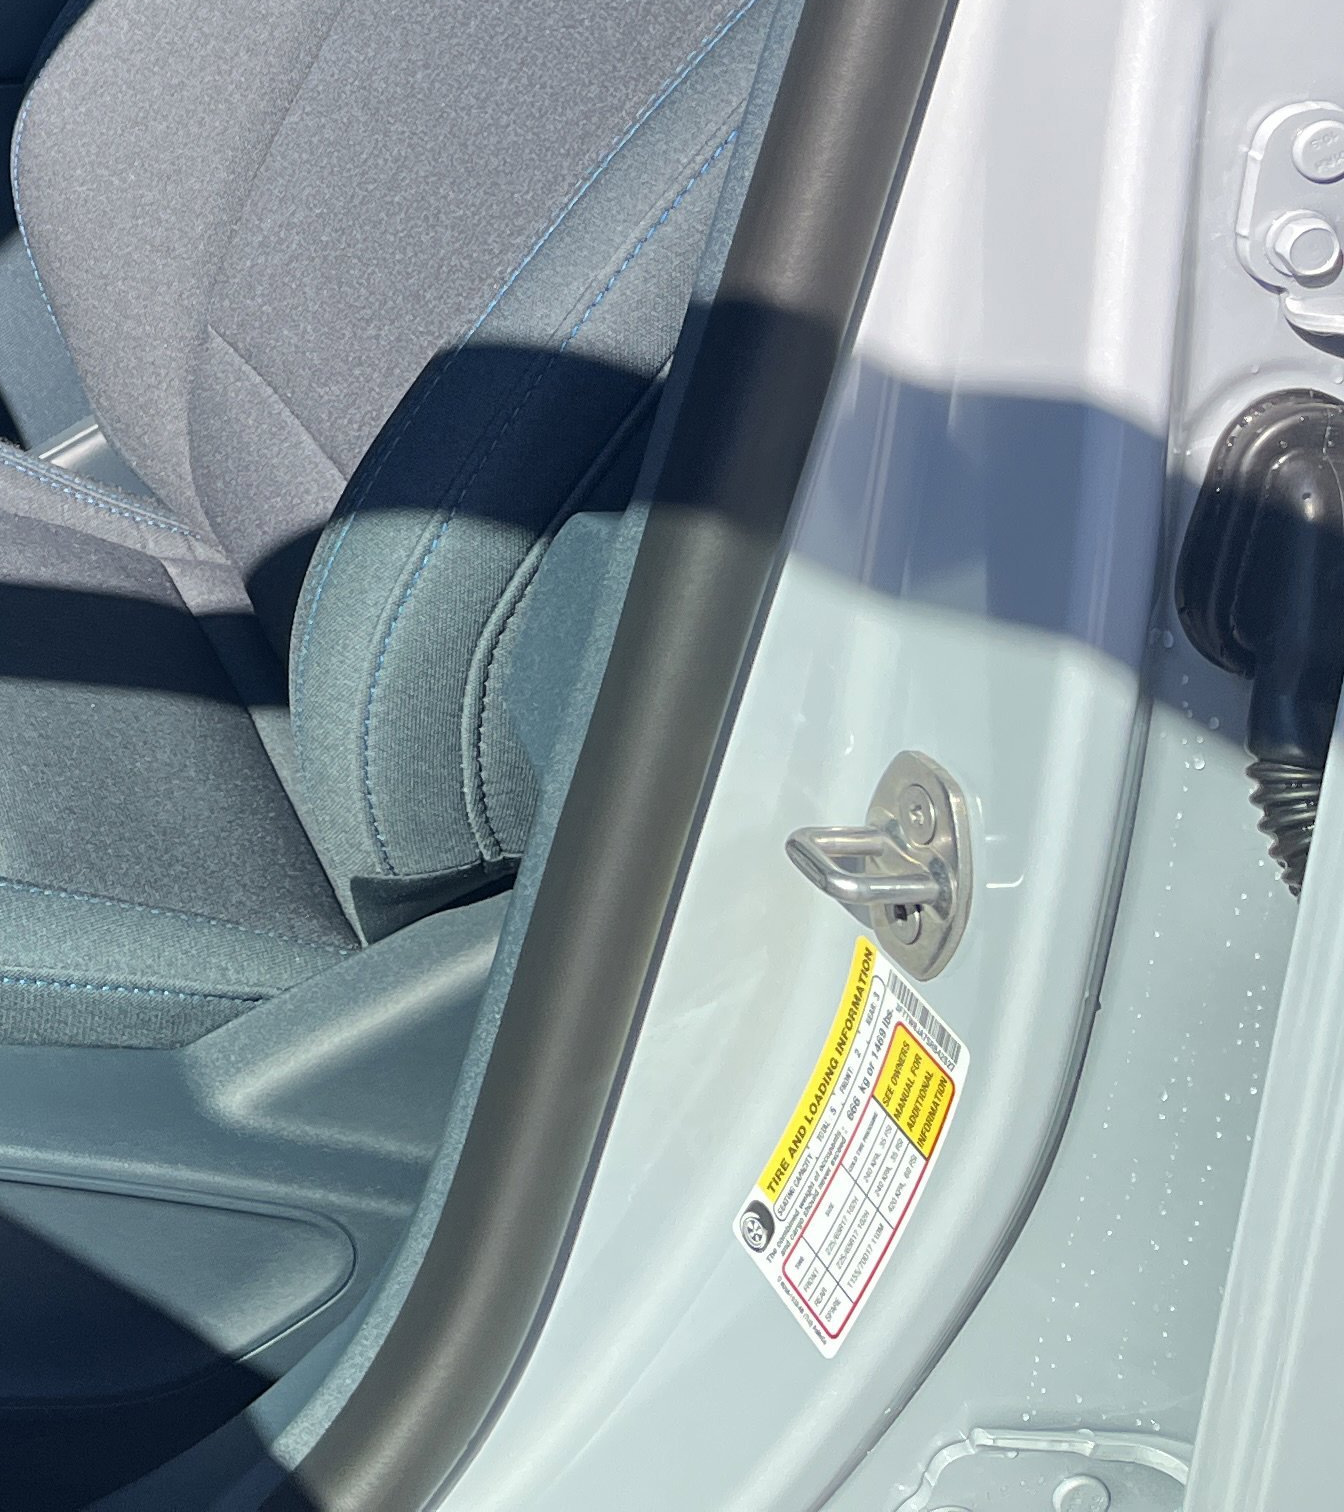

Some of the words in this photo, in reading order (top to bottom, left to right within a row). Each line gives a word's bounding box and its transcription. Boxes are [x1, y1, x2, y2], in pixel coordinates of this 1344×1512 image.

[766, 1156, 791, 1194] TIRE
[787, 1124, 808, 1159] AND
[804, 1056, 839, 1125] LOADING
[834, 946, 874, 1056] INFORMATION
[845, 1095, 862, 1121] 666
[858, 1076, 872, 1094] kg
[866, 1061, 876, 1077] or
[871, 1027, 887, 1060] 1469
[882, 1085, 895, 1108] SEE
[893, 1076, 916, 1121] MANUAL
[912, 1052, 923, 1077] FOR
[906, 1069, 934, 1132] ADDITIONAL
[917, 1075, 949, 1149] INFORMATION
